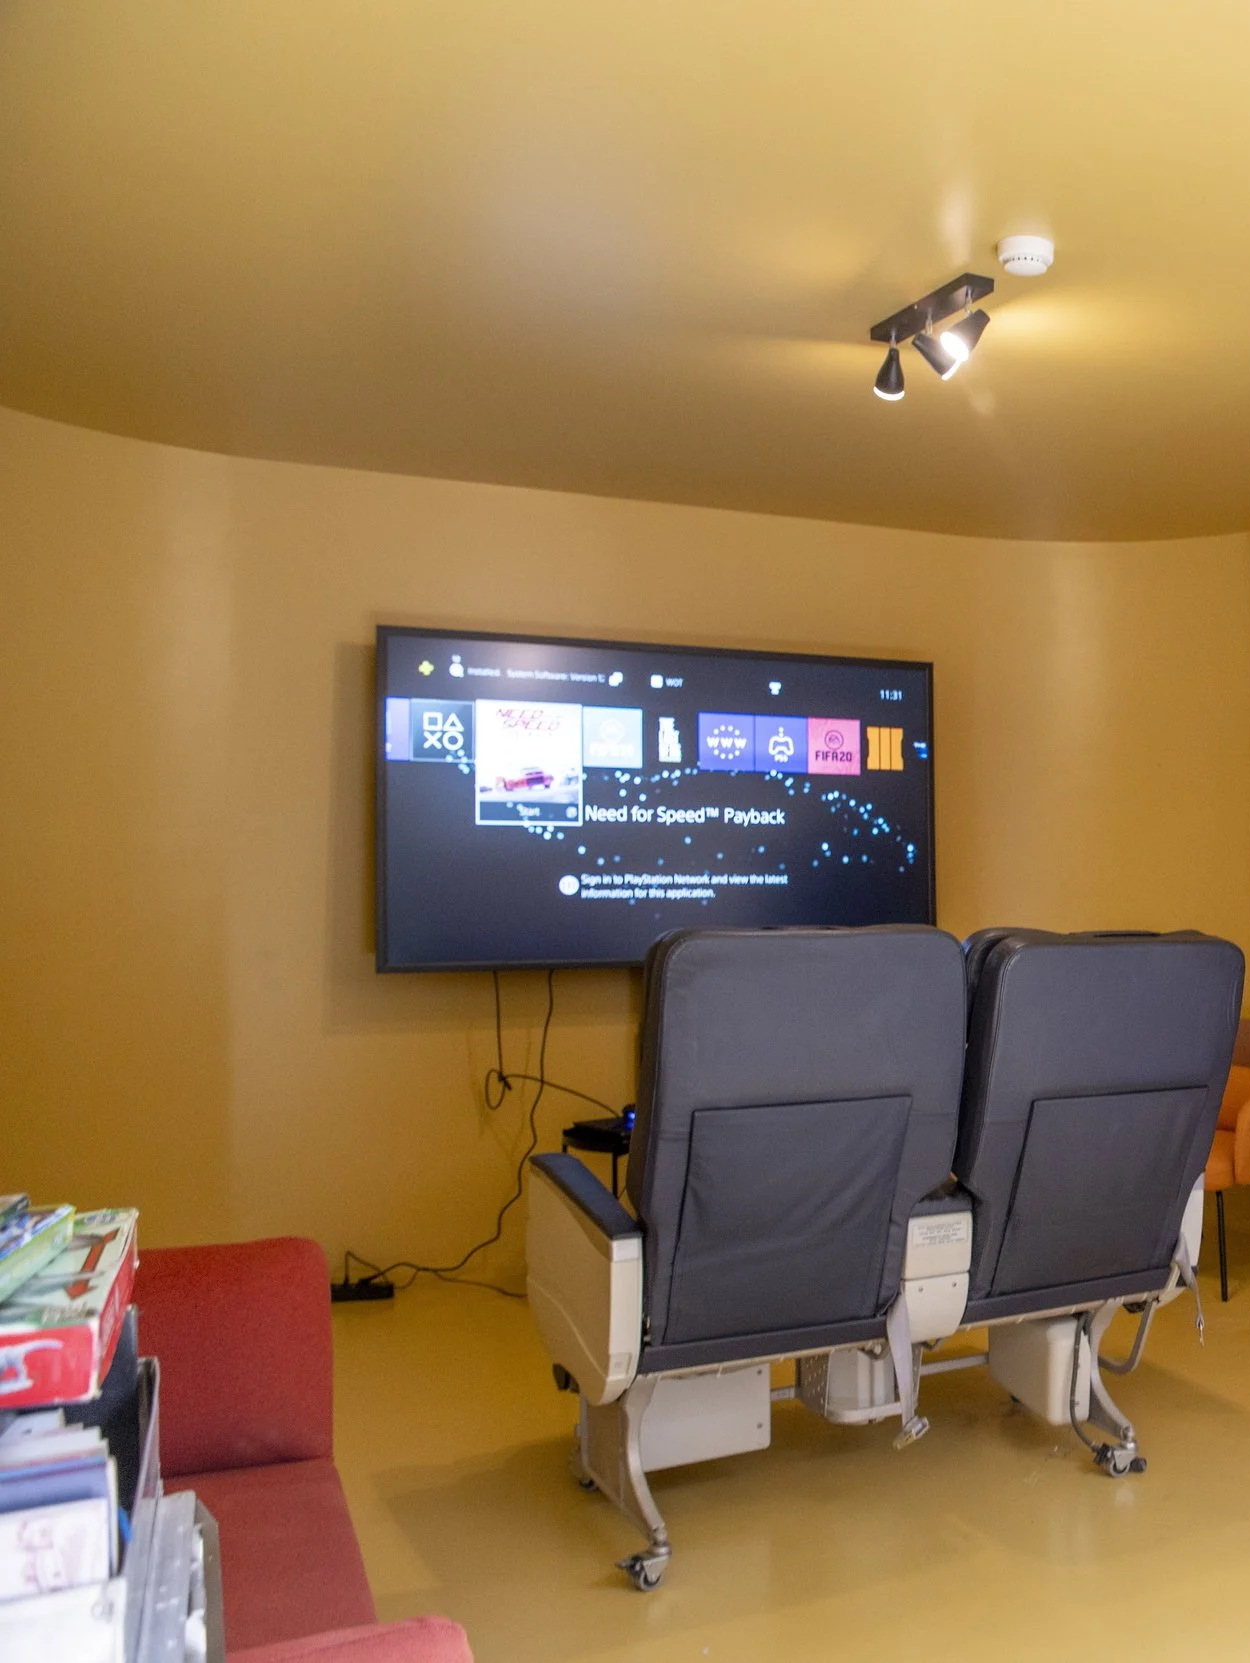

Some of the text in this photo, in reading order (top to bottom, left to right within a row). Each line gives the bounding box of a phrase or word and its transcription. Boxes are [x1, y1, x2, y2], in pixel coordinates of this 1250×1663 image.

[879, 689, 903, 701] 11:31
[584, 804, 628, 823] Need
[630, 804, 654, 823] for
[723, 806, 786, 828] Payback
[581, 873, 788, 887] Sign in to PlayStation Network and view the latest
[580, 888, 716, 900] information for this application.
